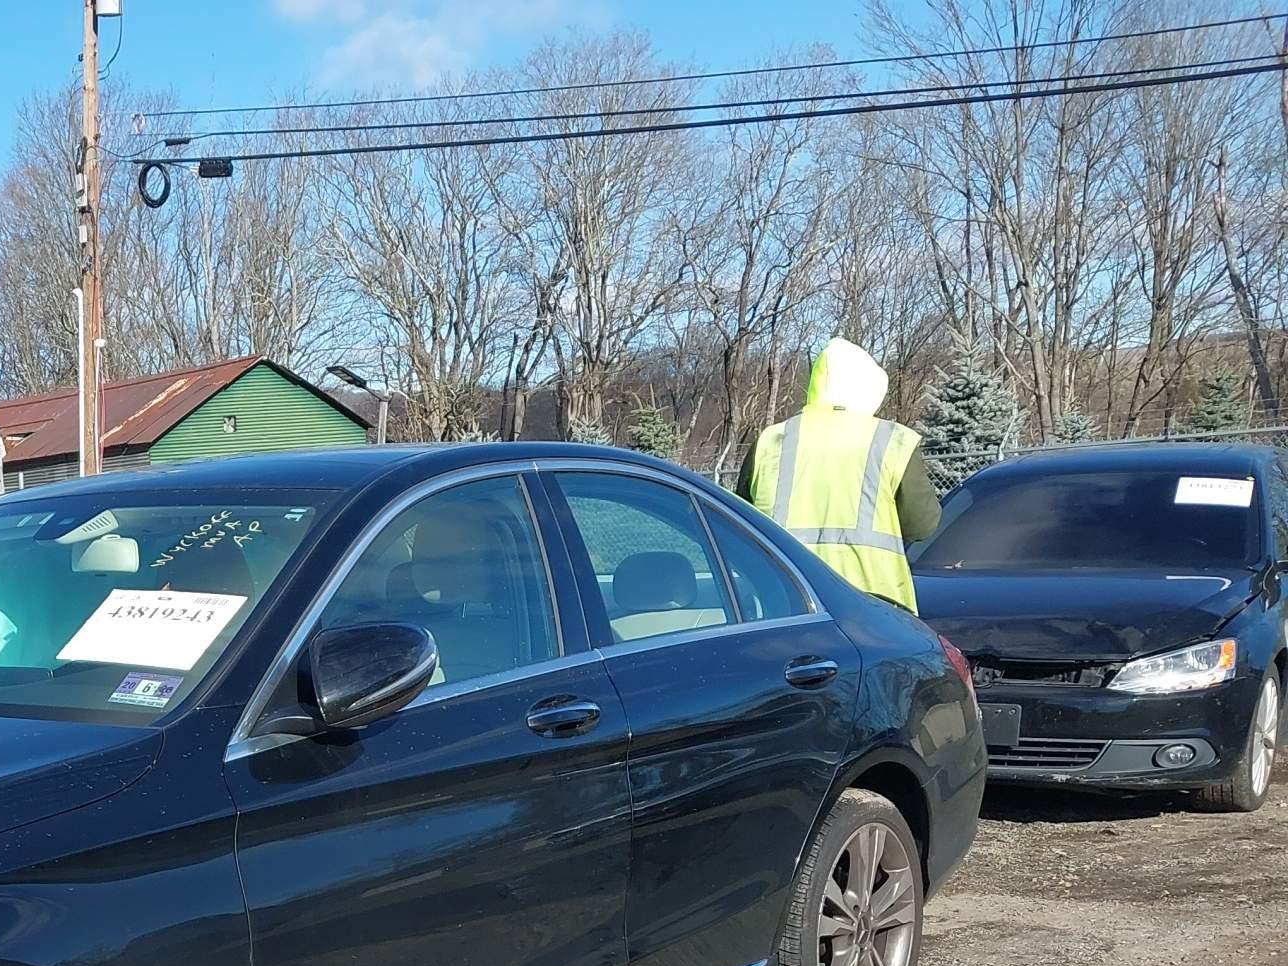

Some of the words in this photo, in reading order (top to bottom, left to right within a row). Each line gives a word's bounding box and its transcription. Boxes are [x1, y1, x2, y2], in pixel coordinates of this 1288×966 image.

[107, 606, 216, 623] 43819243
[121, 681, 136, 690] 20
[142, 682, 153, 693] 6
